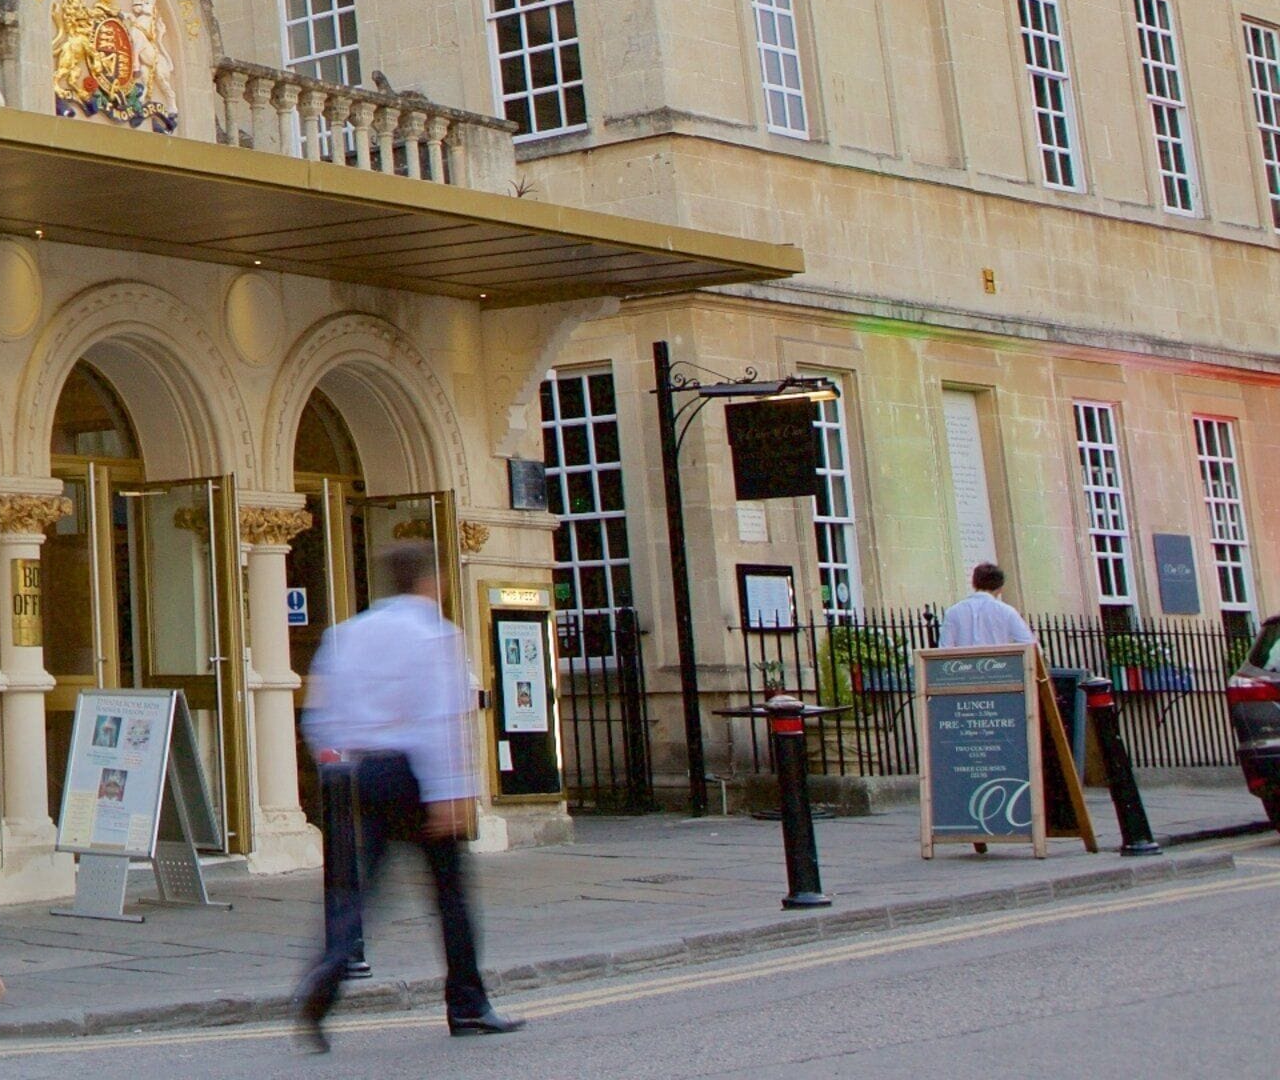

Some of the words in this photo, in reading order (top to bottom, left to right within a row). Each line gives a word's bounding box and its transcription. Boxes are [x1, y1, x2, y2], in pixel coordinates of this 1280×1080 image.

[23, 567, 40, 588] BO
[956, 700, 995, 710] LUNCH
[940, 720, 959, 729] PRE
[967, 718, 1016, 728] THEATRE
